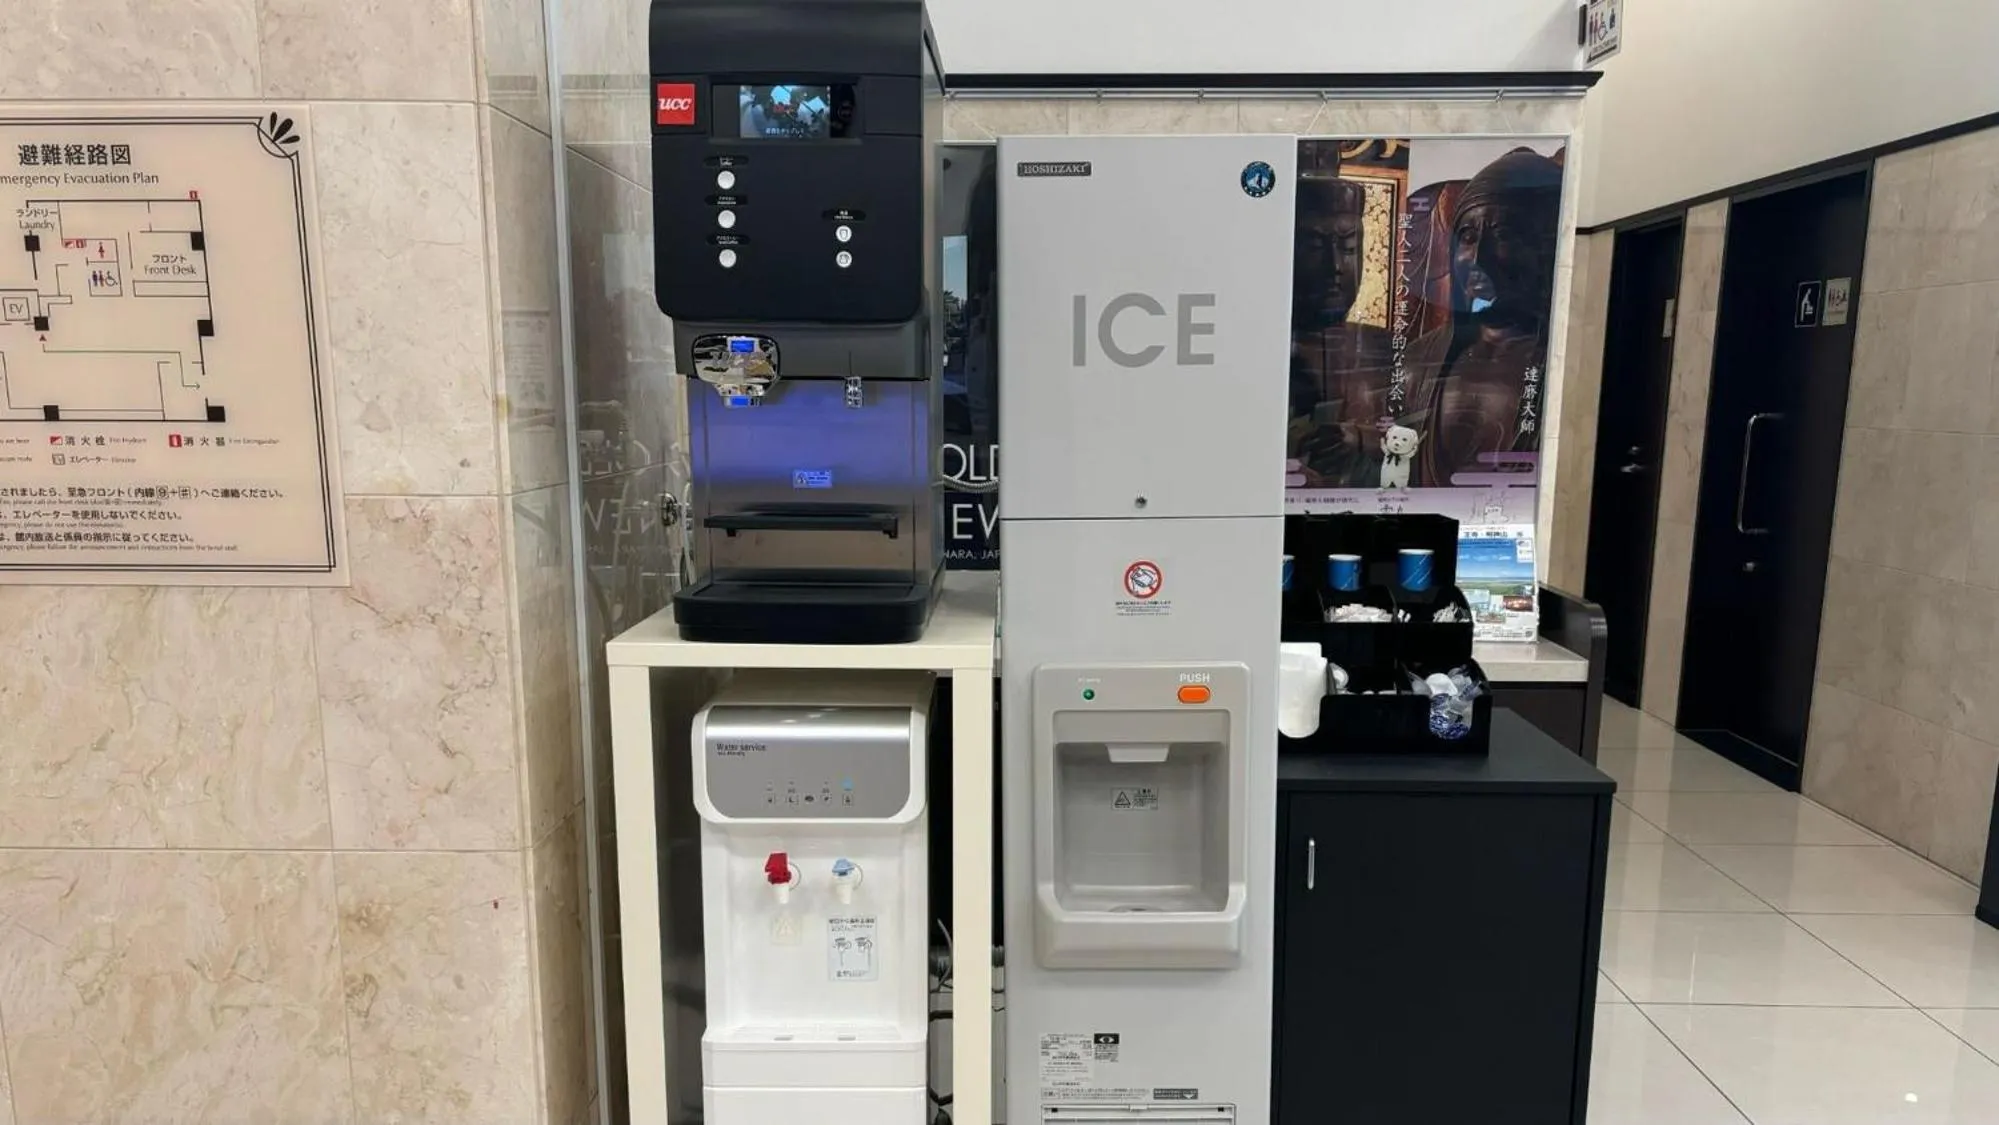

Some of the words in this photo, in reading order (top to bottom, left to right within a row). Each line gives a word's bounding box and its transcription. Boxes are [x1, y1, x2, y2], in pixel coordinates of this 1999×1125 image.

[18, 144, 132, 166] 避難経路図
[1021, 163, 1088, 176] HOSHIZAKI
[64, 172, 130, 184] Evacuation
[133, 172, 159, 184] Plan
[16, 208, 58, 218] ランドリー
[19, 220, 55, 232] Laundry
[152, 254, 187, 264] フロント
[144, 265, 170, 276] Front
[172, 265, 197, 276] Desk
[9, 303, 23, 313] EV
[1072, 292, 1216, 368] ICE
[1179, 672, 1210, 683] PUSH
